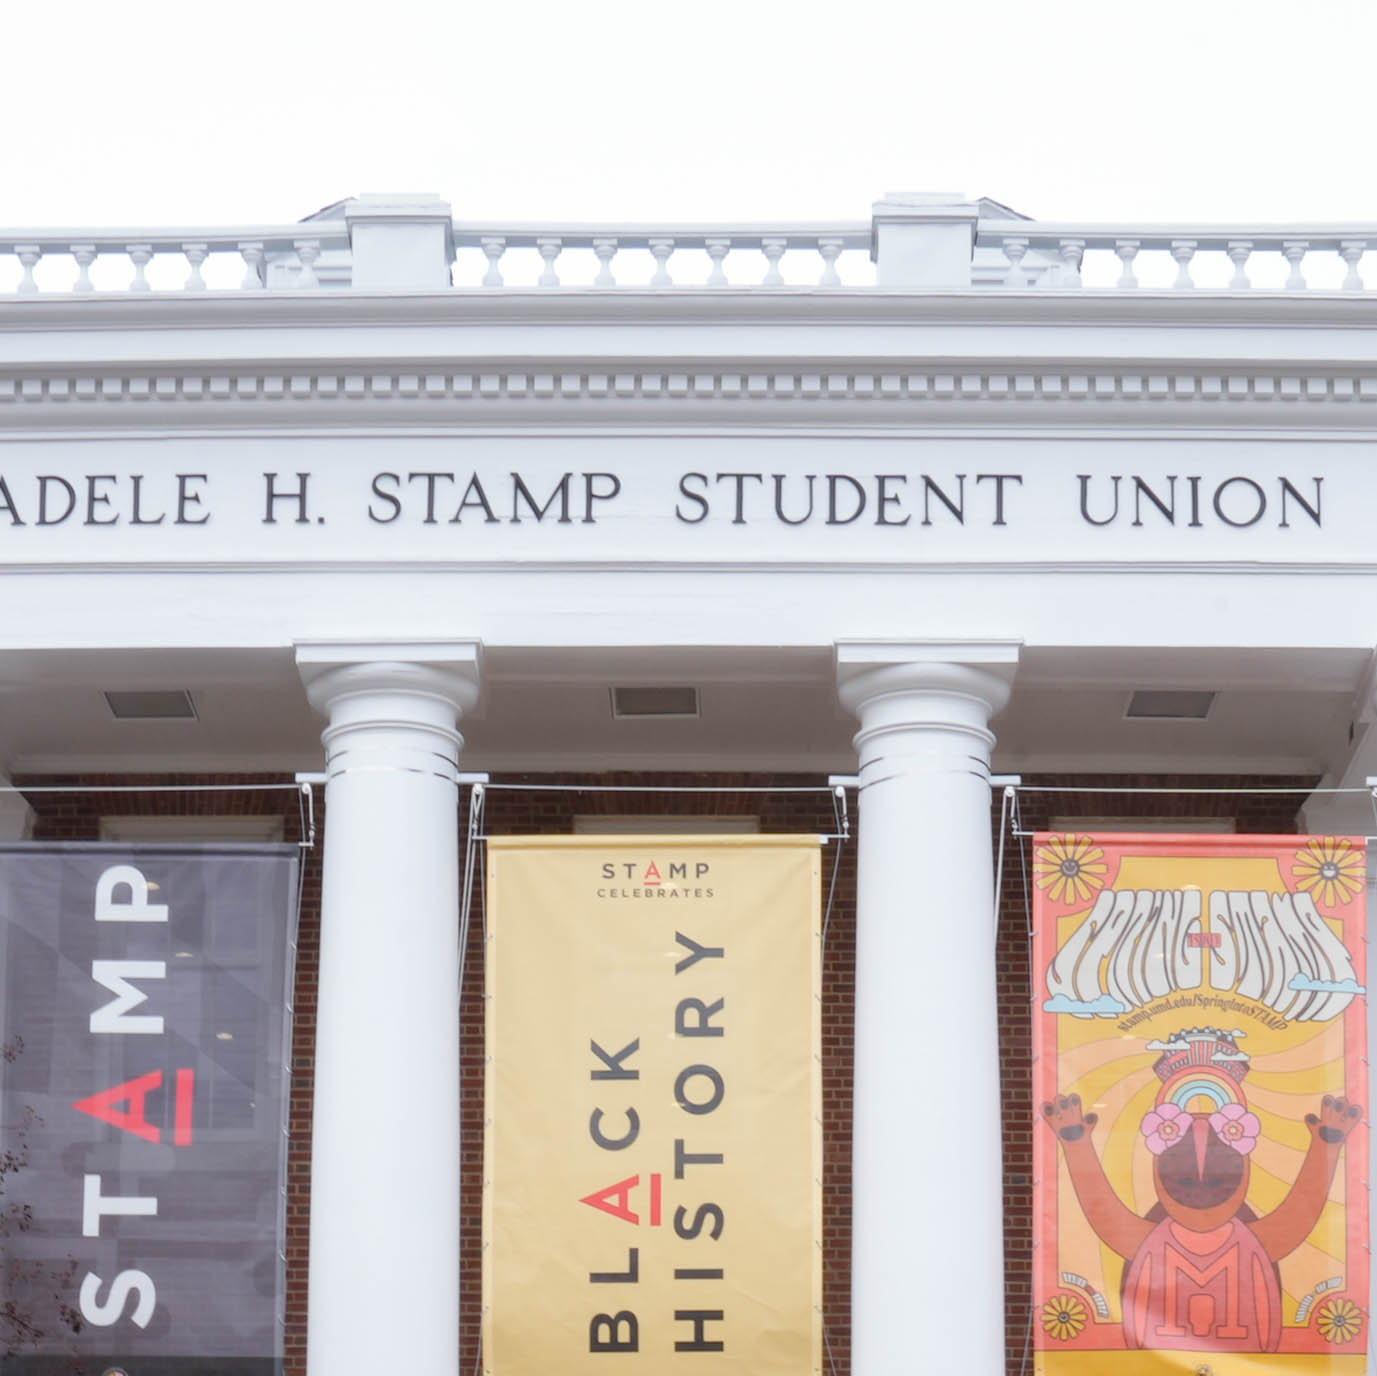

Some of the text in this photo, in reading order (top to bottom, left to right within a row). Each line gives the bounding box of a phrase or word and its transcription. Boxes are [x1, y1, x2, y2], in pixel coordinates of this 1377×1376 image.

[262, 472, 325, 526] H.
[368, 472, 622, 526] STAMP
[675, 472, 1024, 527] STUDENT
[1076, 474, 1325, 528] UNION
[597, 888, 715, 899] CELEBRATES
[601, 860, 710, 886] STAMP
[71, 865, 195, 1330] STAMP
[673, 930, 725, 1353] HISTORY
[577, 1037, 662, 1353] BLACK
